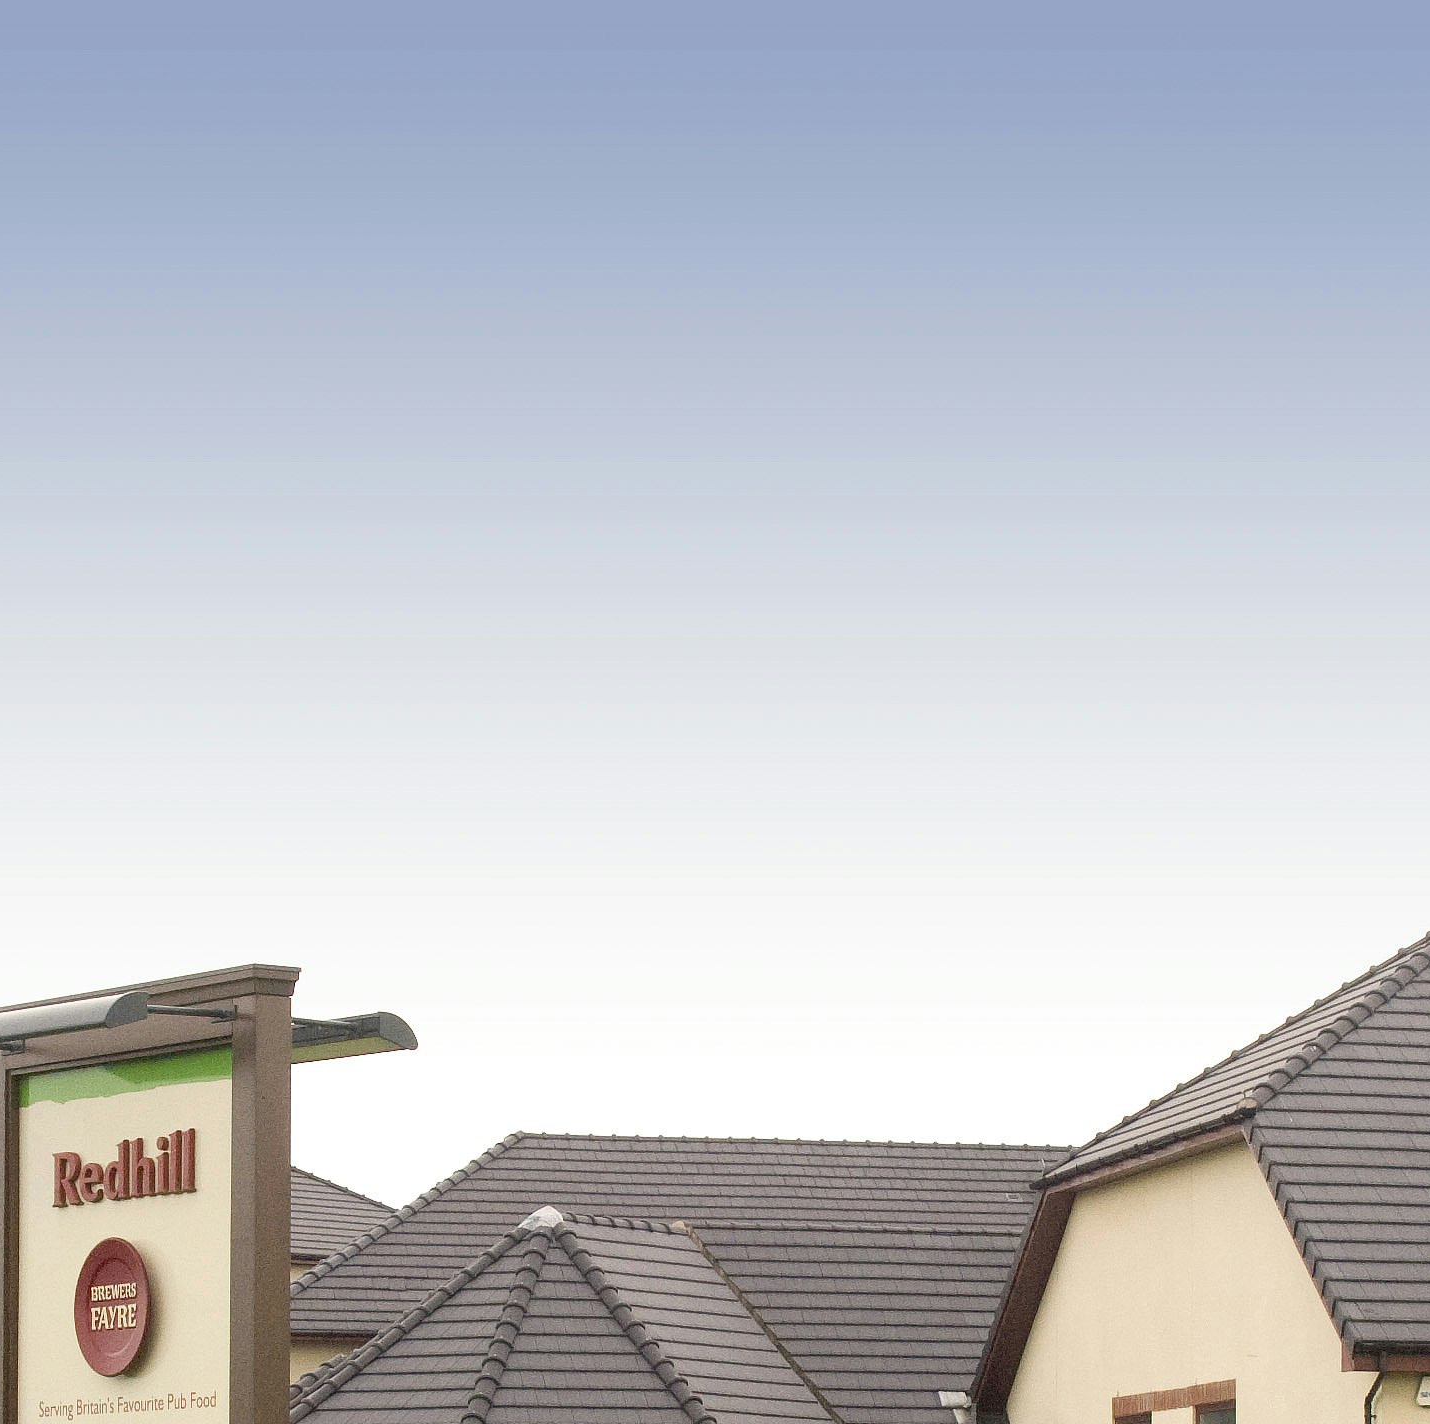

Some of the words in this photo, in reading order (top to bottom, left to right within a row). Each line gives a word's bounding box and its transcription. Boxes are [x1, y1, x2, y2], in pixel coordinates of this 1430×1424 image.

[52, 1128, 197, 1208] Redhill
[90, 1282, 138, 1302] BREWERS
[90, 1303, 138, 1331] FAYRE
[39, 1401, 74, 1421] Serving
[76, 1397, 115, 1416] Britain's
[117, 1396, 165, 1413] Favourite
[167, 1393, 187, 1410] Pub
[190, 1390, 217, 1409] Food
